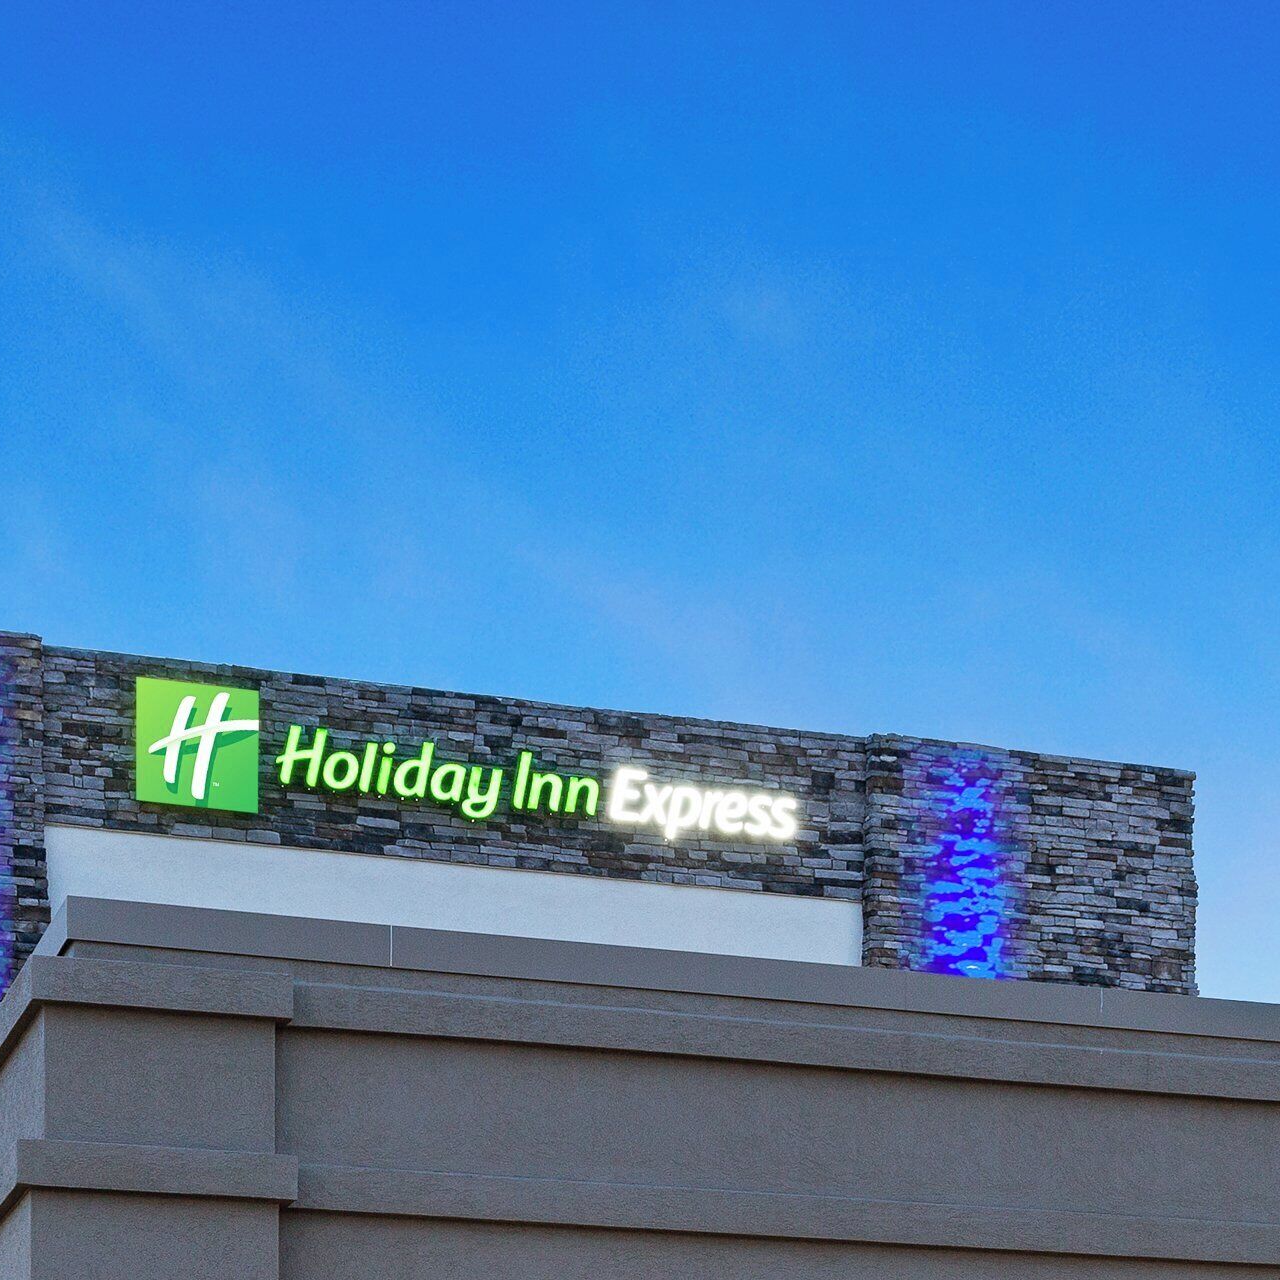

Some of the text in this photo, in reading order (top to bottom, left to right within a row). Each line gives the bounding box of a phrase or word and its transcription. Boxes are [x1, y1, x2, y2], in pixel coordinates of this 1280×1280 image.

[275, 725, 798, 840] Holiday Inn Express
